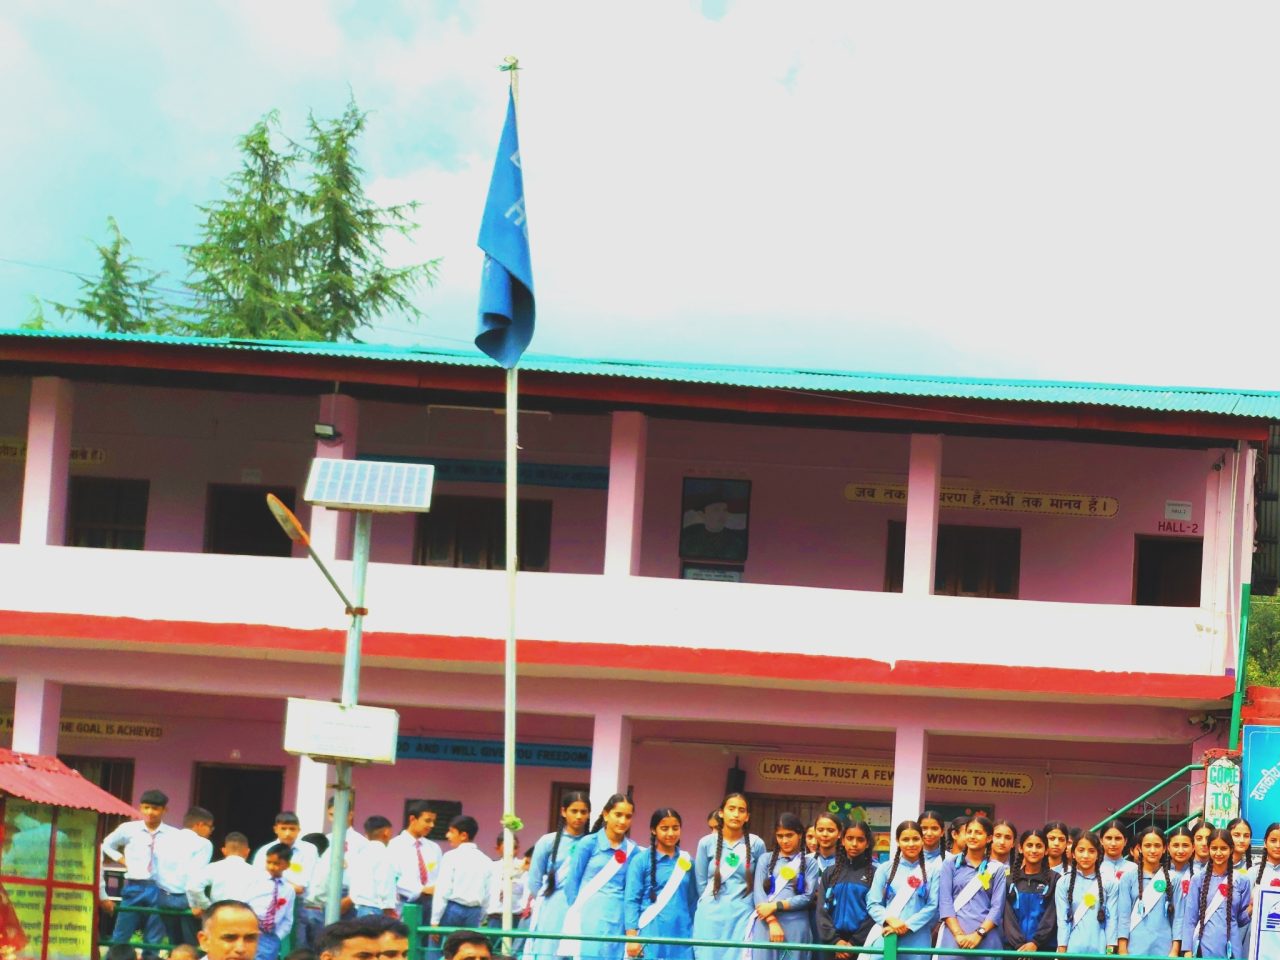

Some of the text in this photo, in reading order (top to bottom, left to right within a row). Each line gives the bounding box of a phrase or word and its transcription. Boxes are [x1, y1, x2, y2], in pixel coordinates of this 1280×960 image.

[1021, 496, 1042, 508] तक
[1049, 498, 1082, 511] मानव
[1158, 521, 1198, 533] HALL-2
[76, 722, 101, 733] GOAL
[105, 724, 114, 735] IS
[117, 725, 163, 737] ACHIEVED
[452, 745, 476, 756] WILL
[537, 750, 588, 762] FREEDOM
[763, 762, 790, 774] LOVE
[794, 765, 818, 777] ALL,
[823, 766, 857, 779] TRUST
[861, 769, 870, 780] A
[927, 773, 968, 785] WRONG
[973, 776, 986, 787] TO
[991, 777, 1026, 789] NONE.
[1209, 767, 1239, 784] COME
[1212, 792, 1232, 811] TO
